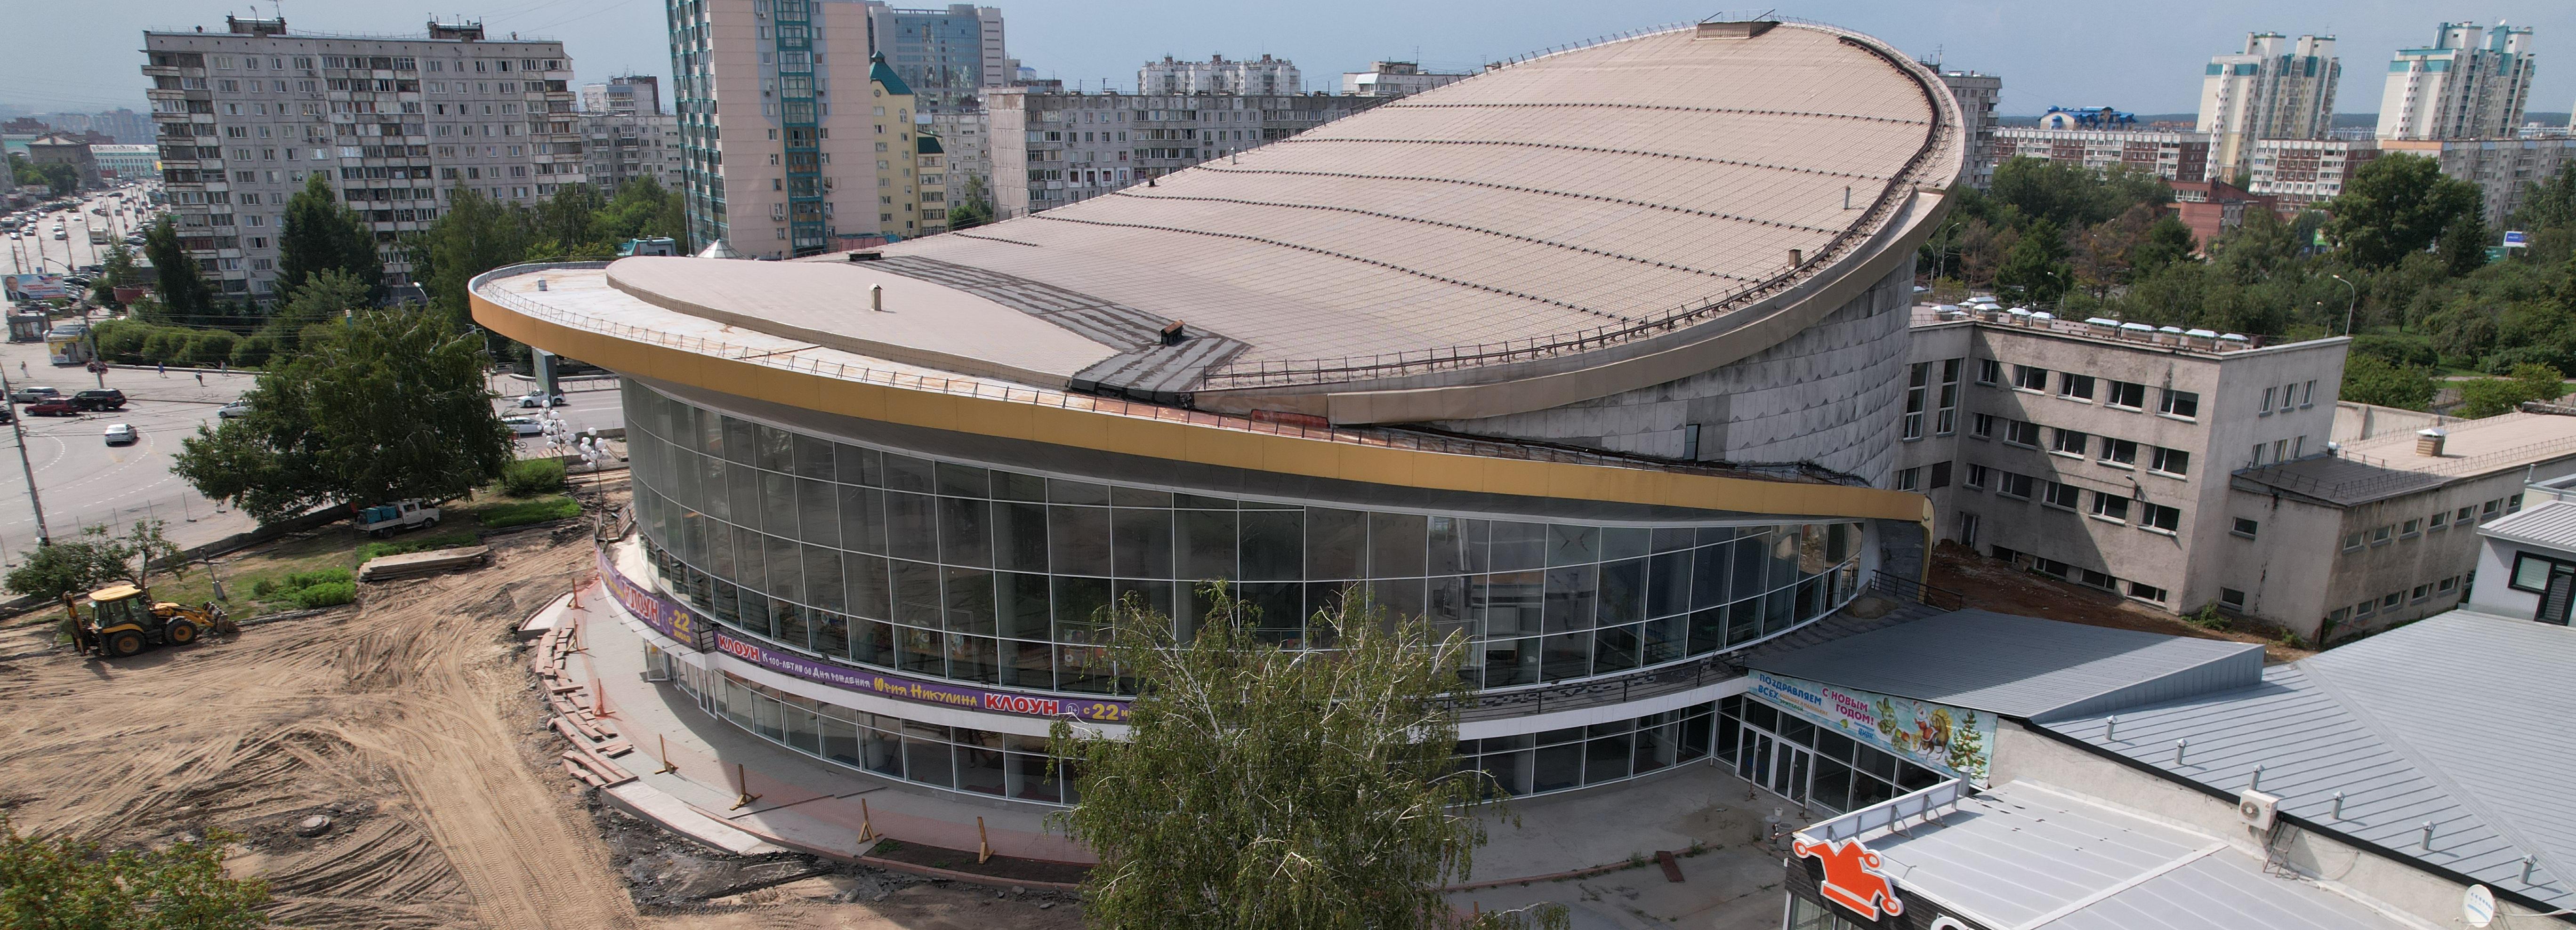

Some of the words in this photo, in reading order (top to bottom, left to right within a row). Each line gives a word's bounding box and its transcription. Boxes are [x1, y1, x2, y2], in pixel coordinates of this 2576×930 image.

[623, 581, 660, 626] КЛОУН
[674, 609, 690, 633] 22
[718, 633, 760, 662] КЛОУН
[762, 651, 768, 662] К
[985, 692, 1059, 716] КЛОУН
[1092, 704, 1119, 721] 22
[1760, 673, 1822, 706] ПОЗДРАВЛЯЕМ
[1758, 685, 1779, 699] ВСЕХ
[1822, 688, 1828, 697] С
[1831, 691, 1868, 712] НОВЫМ
[1836, 704, 1874, 725] ГОДОМ!
